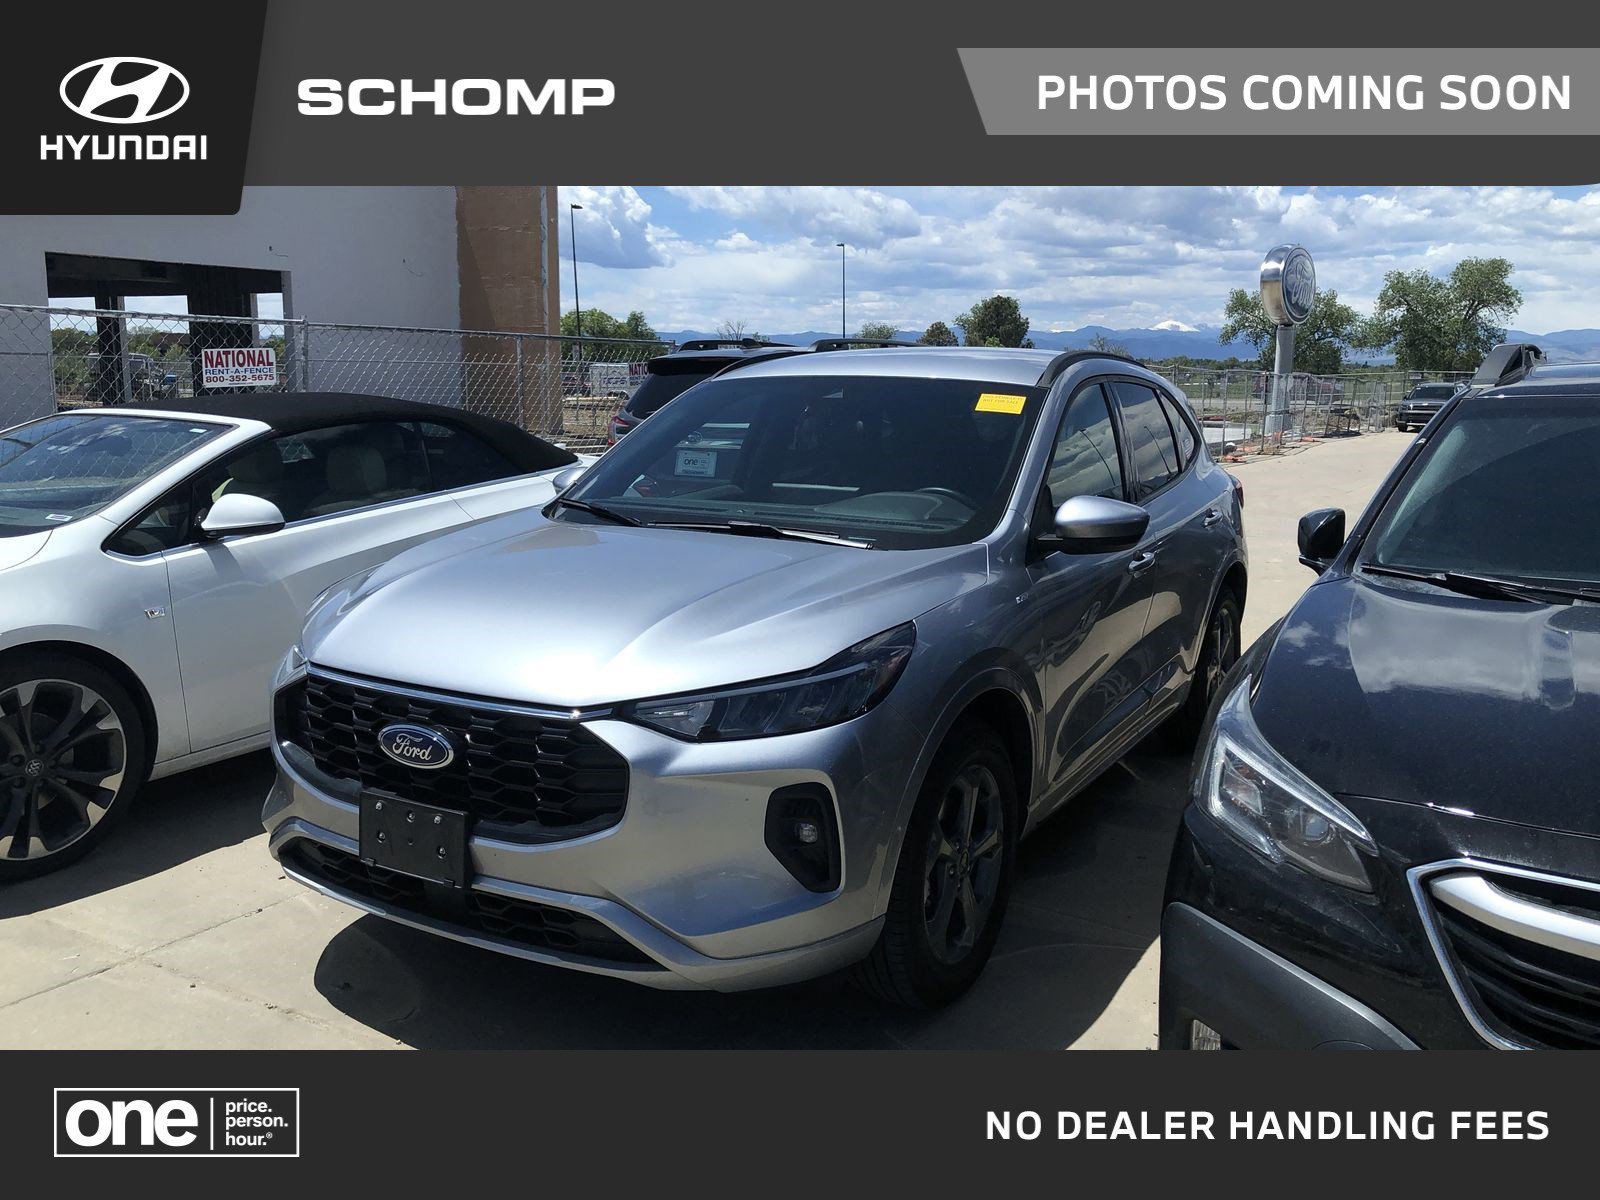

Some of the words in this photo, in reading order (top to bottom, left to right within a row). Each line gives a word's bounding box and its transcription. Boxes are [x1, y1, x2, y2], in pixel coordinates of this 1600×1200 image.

[204, 350, 274, 368] NATIONAL
[204, 367, 274, 376] RENT-A-FENCE
[628, 363, 649, 376] NATIO
[205, 374, 274, 383] 800-352-5675
[683, 458, 699, 466] one
[392, 733, 433, 761] Ford
